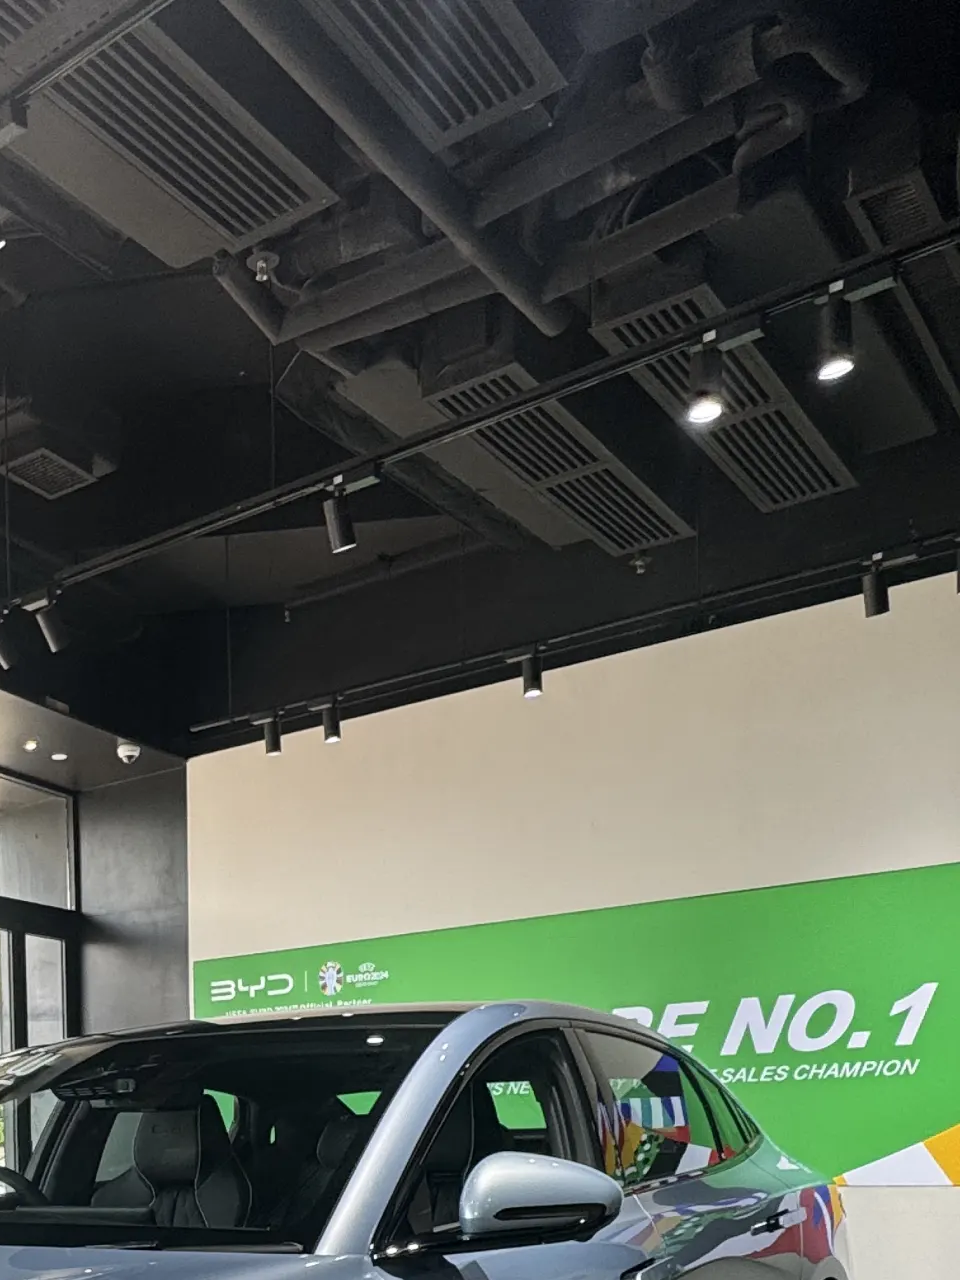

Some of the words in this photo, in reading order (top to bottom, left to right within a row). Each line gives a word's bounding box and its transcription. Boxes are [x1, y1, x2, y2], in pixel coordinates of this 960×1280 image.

[210, 974, 294, 1002] BYD
[720, 1065, 789, 1084] SALES
[794, 1058, 921, 1081] CHAMPION
